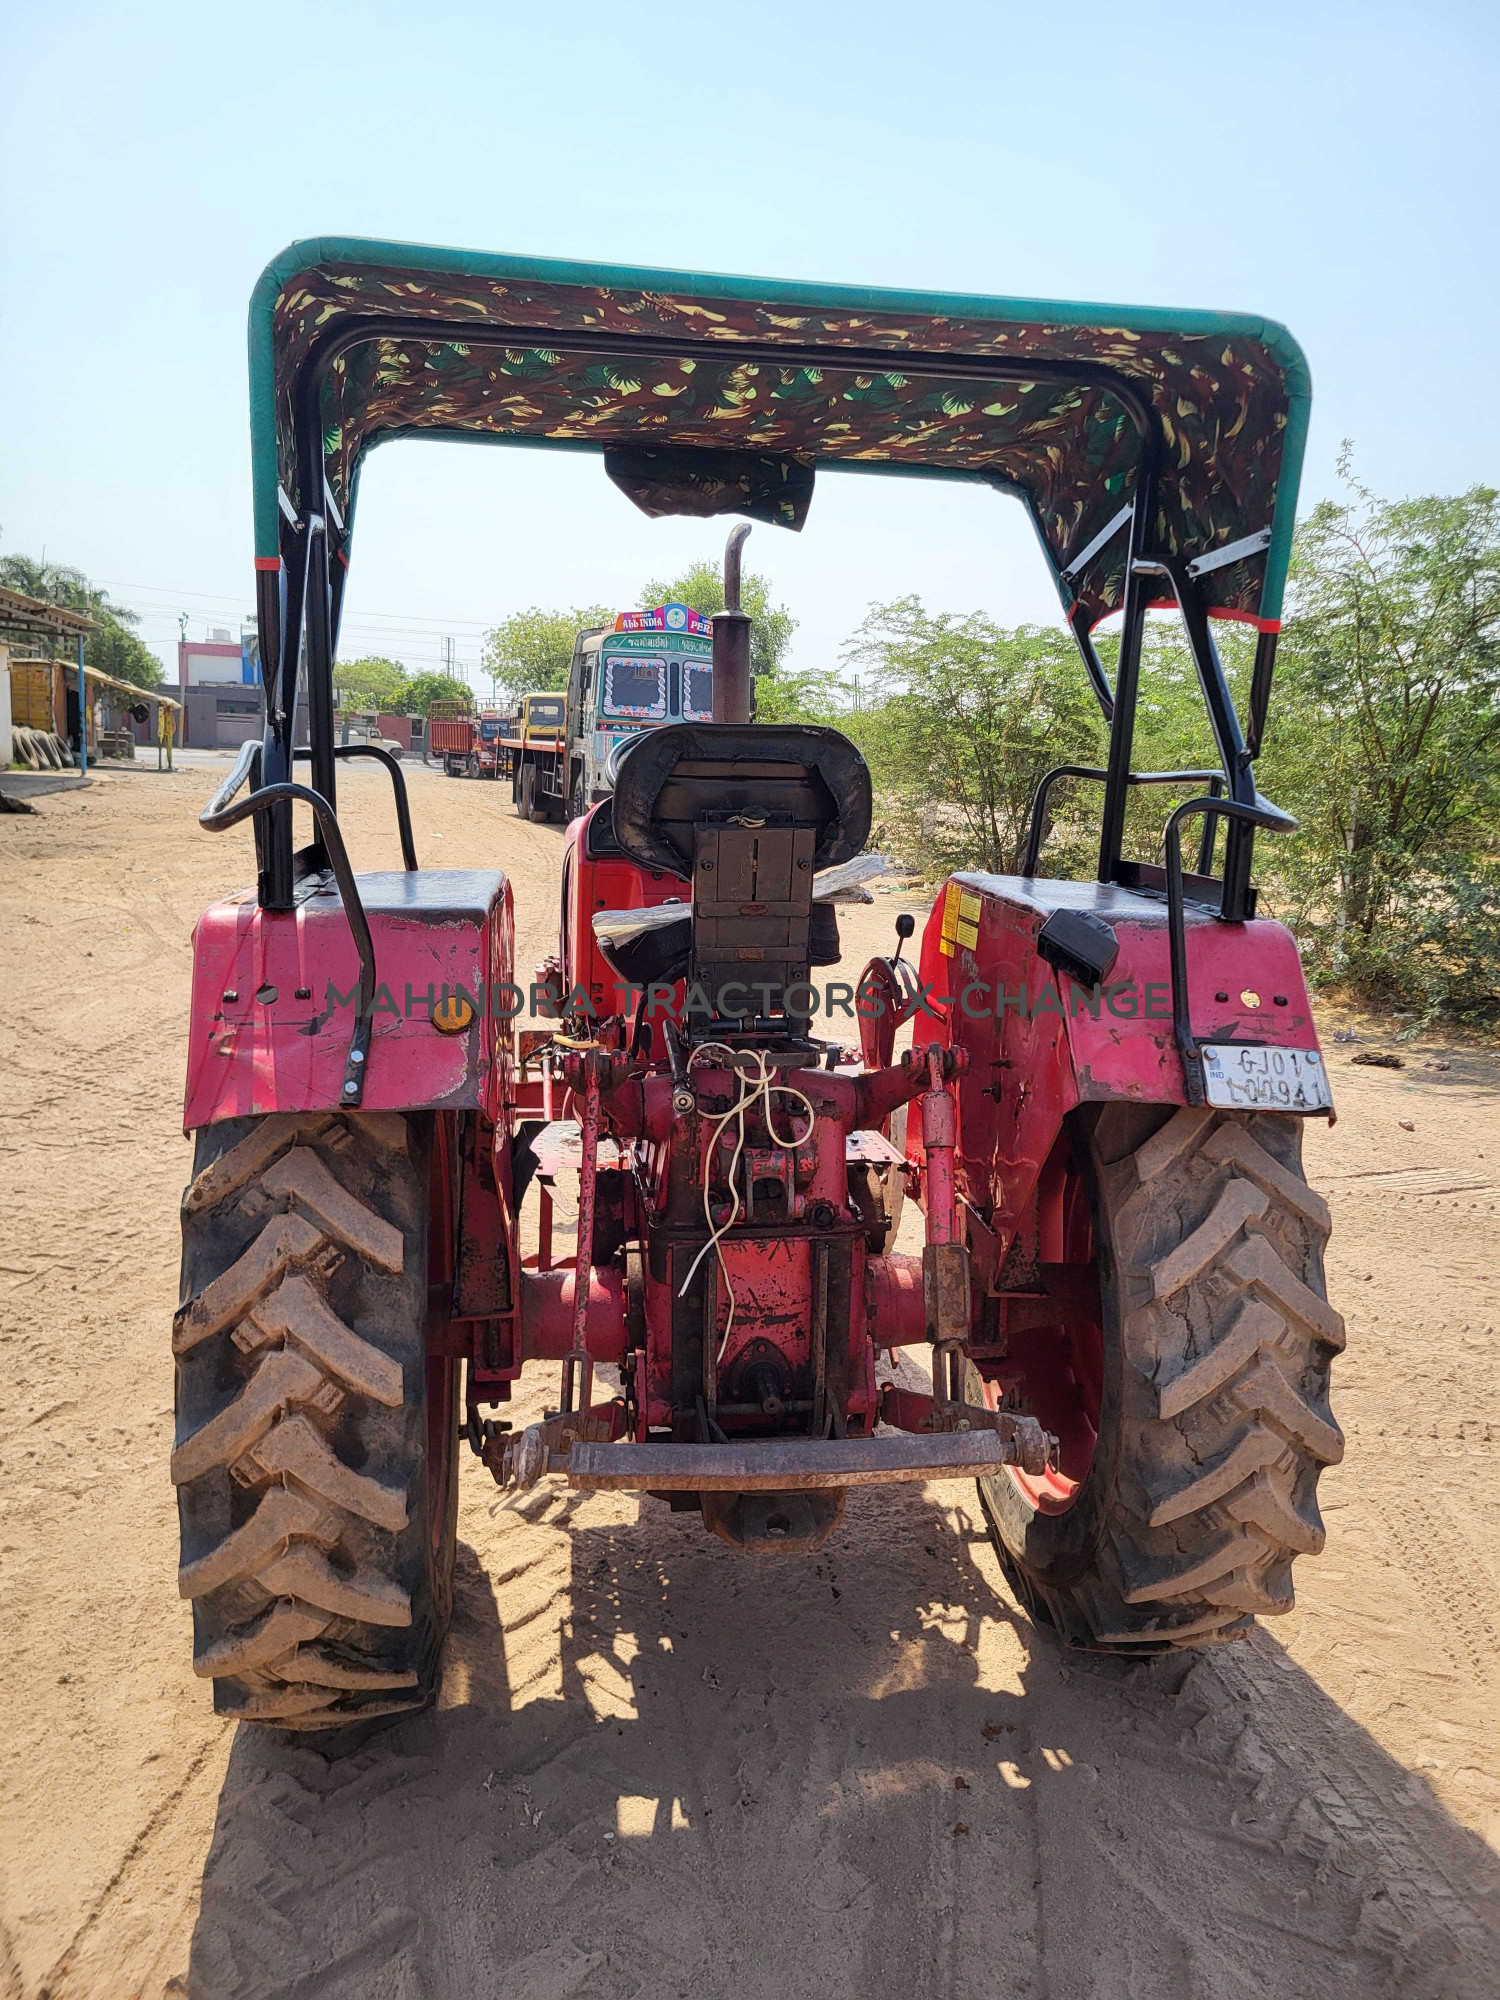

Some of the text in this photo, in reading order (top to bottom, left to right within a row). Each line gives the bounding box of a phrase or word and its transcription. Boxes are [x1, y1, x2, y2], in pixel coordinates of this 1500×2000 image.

[639, 617, 663, 628] INDIA
[690, 620, 713, 634] PER
[1240, 1049, 1302, 1077] GJ01
[1210, 1071, 1225, 1079] IND
